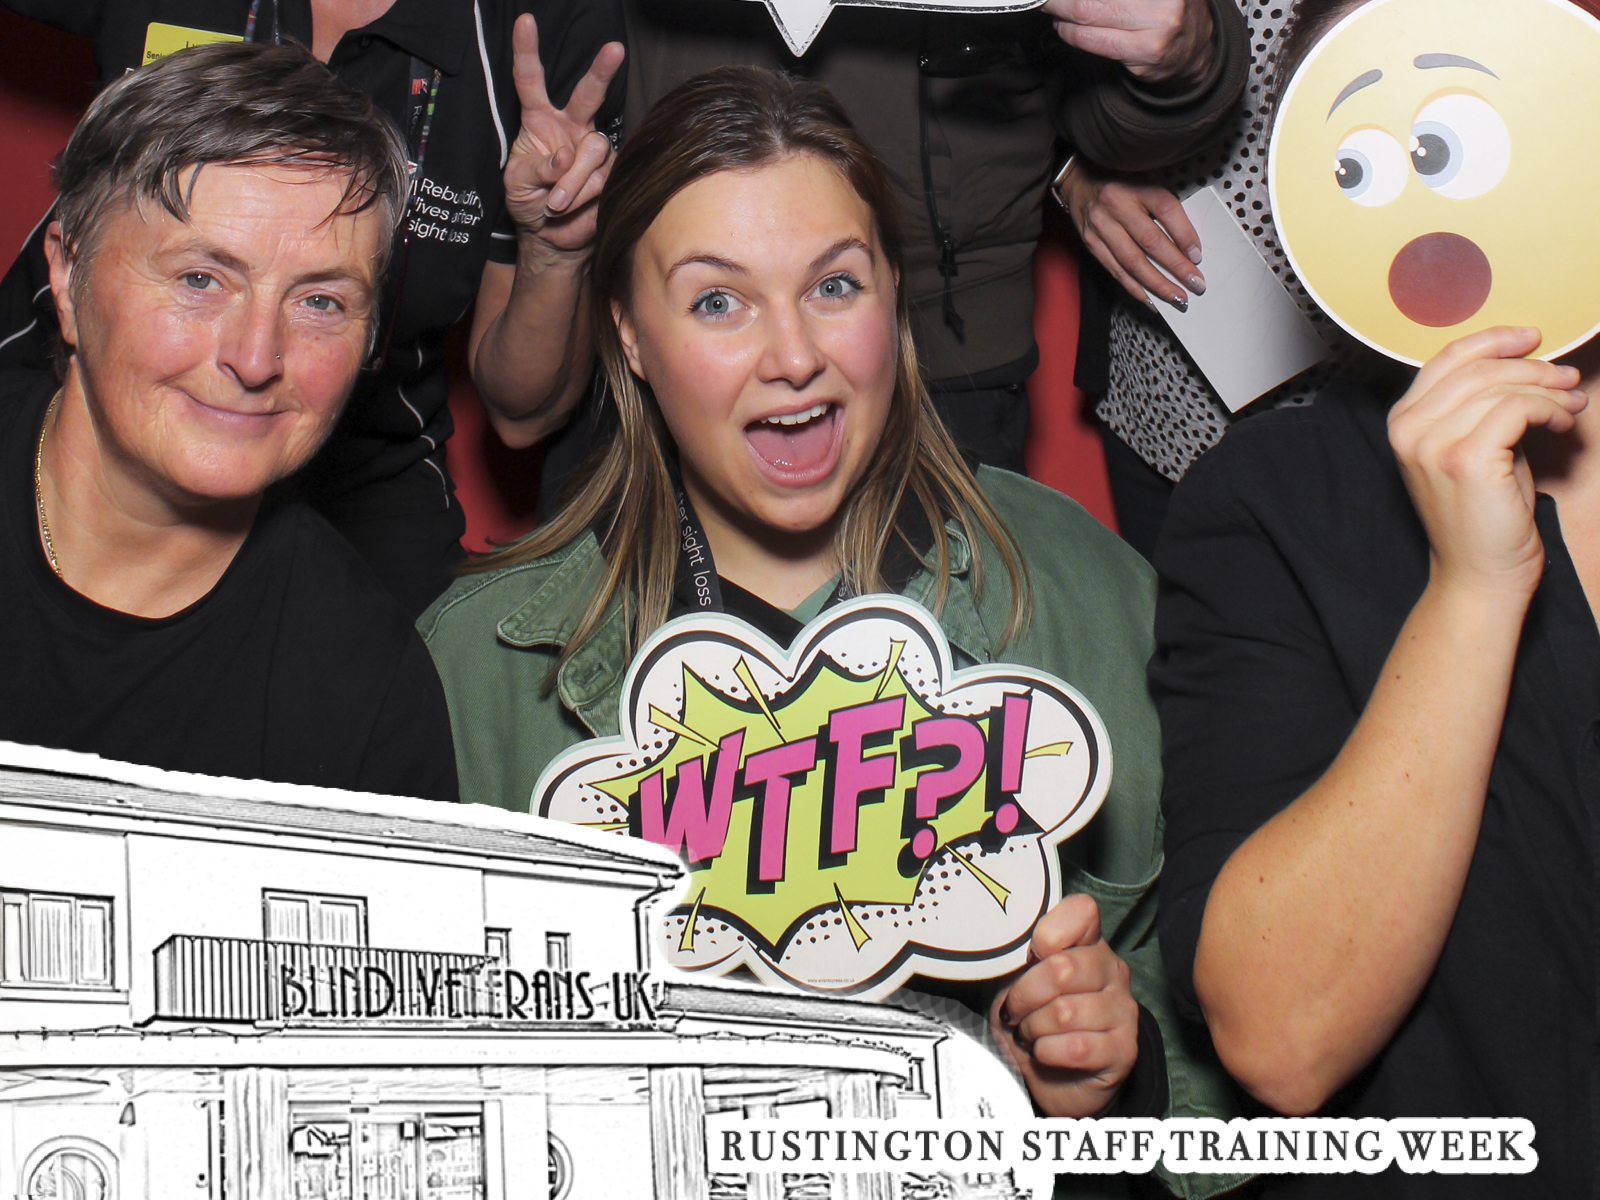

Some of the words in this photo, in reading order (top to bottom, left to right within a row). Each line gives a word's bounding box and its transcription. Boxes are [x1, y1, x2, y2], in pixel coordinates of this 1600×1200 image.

[408, 217, 448, 241] sight
[682, 525, 705, 567] sight
[693, 570, 712, 607] loss
[632, 690, 1034, 890] WTF?!
